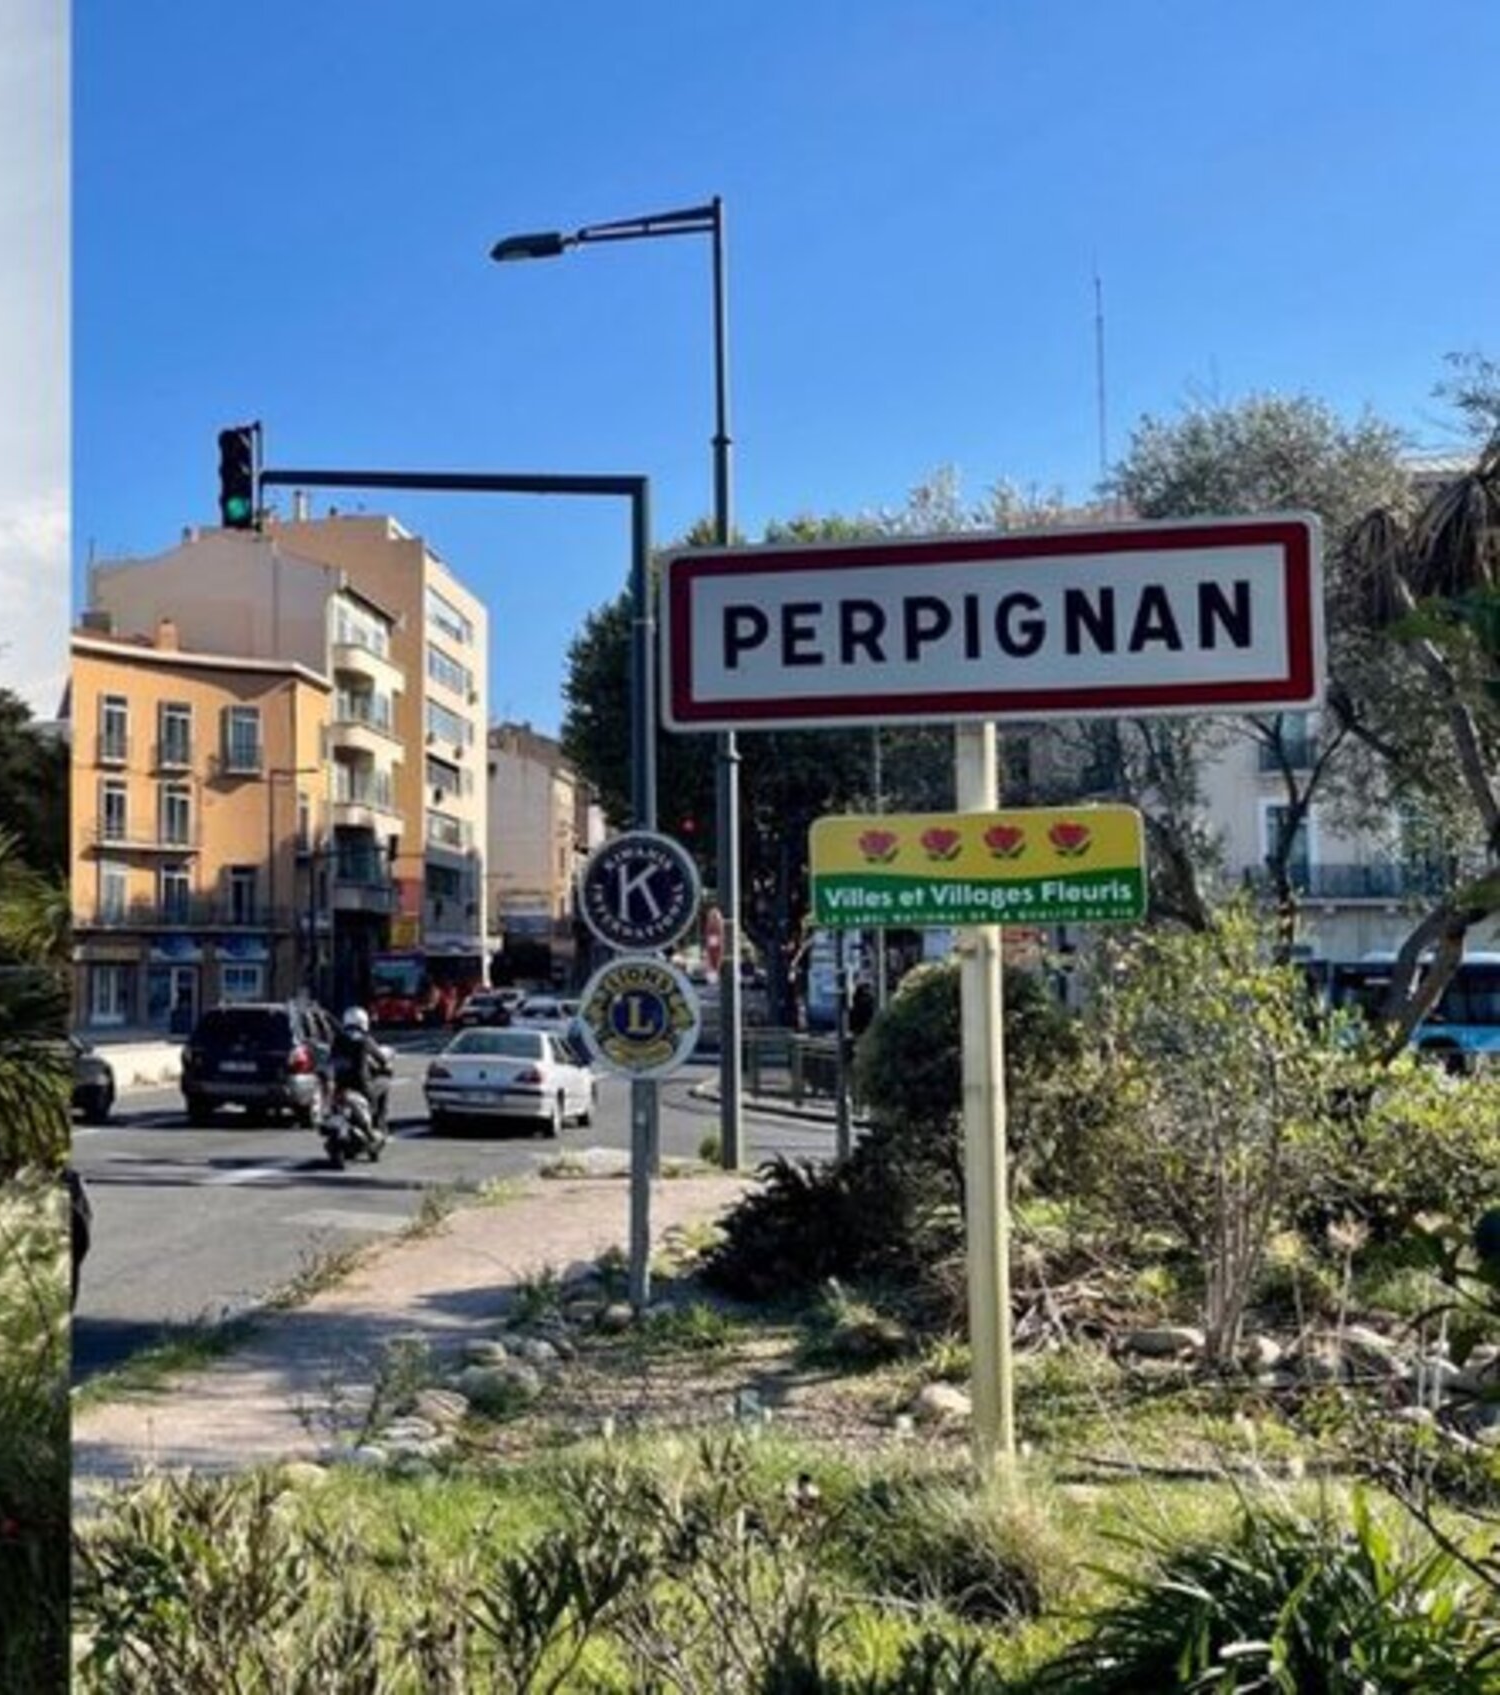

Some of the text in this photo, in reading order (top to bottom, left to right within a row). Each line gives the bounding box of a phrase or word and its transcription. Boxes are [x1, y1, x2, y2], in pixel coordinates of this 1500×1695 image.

[723, 580, 1251, 669] PERPIGNAN
[618, 863, 662, 922] K
[824, 879, 1132, 909] Villes et Villages Fleuris
[627, 996, 654, 1034] L
